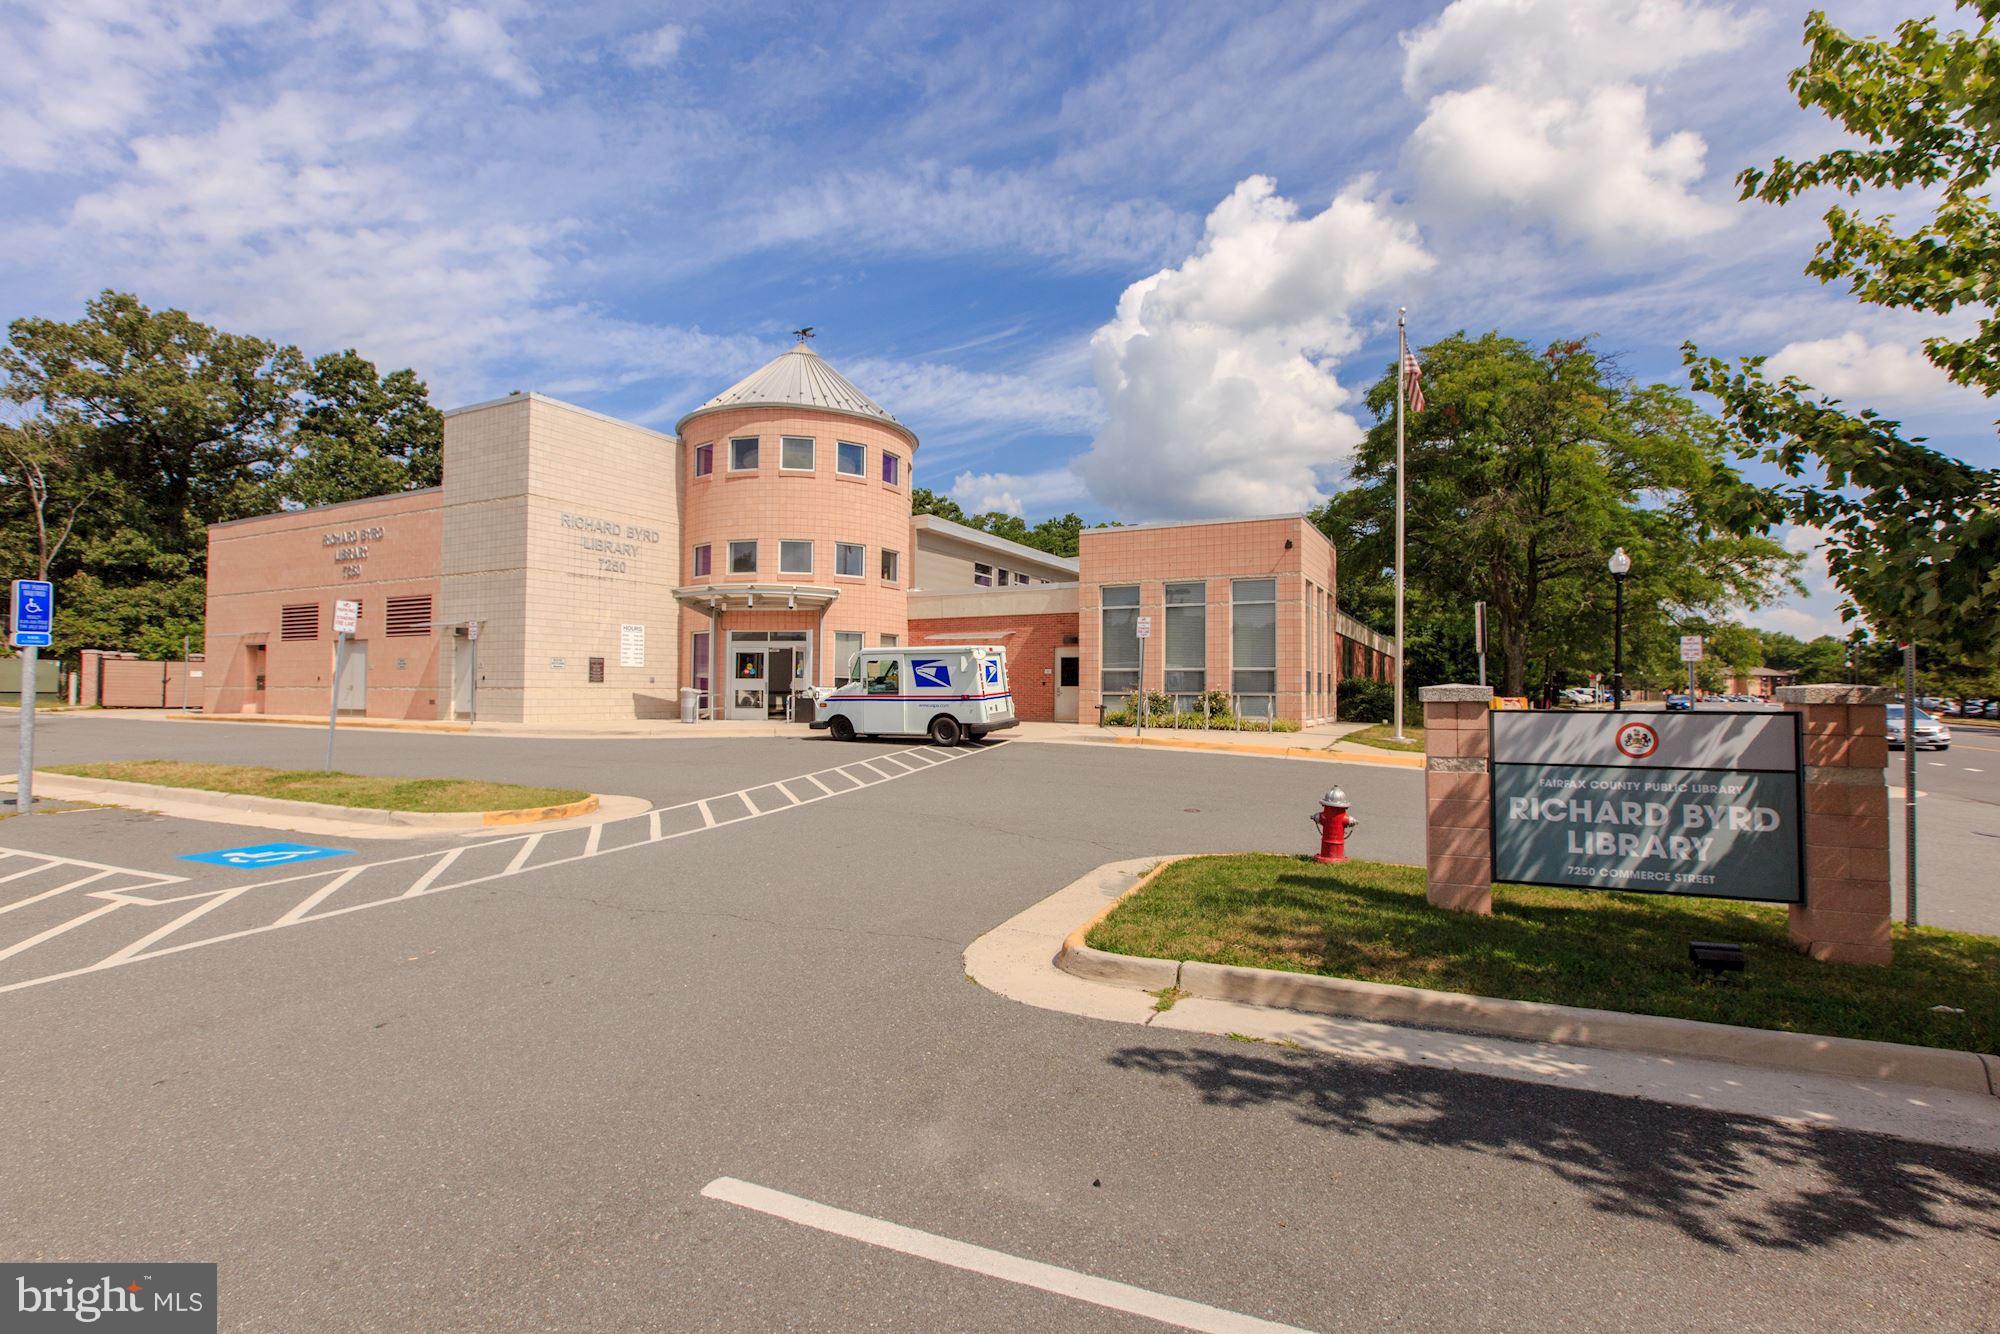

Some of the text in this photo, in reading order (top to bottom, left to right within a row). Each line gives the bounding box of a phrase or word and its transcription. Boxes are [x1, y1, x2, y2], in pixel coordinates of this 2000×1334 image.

[561, 513, 660, 544] RICHARD BYRD
[335, 546, 369, 561] LIBRARY
[582, 537, 641, 558] LIBRARY
[598, 558, 626, 574] 7250
[1539, 778, 1744, 795] FAIRFAX COUNTY PUBLIC LIBRARY
[1509, 797, 1780, 832] RICHARD BYRD
[1567, 830, 1714, 861] LIBRARY
[1567, 865, 1716, 885] 7250 COMMERCE STREET
